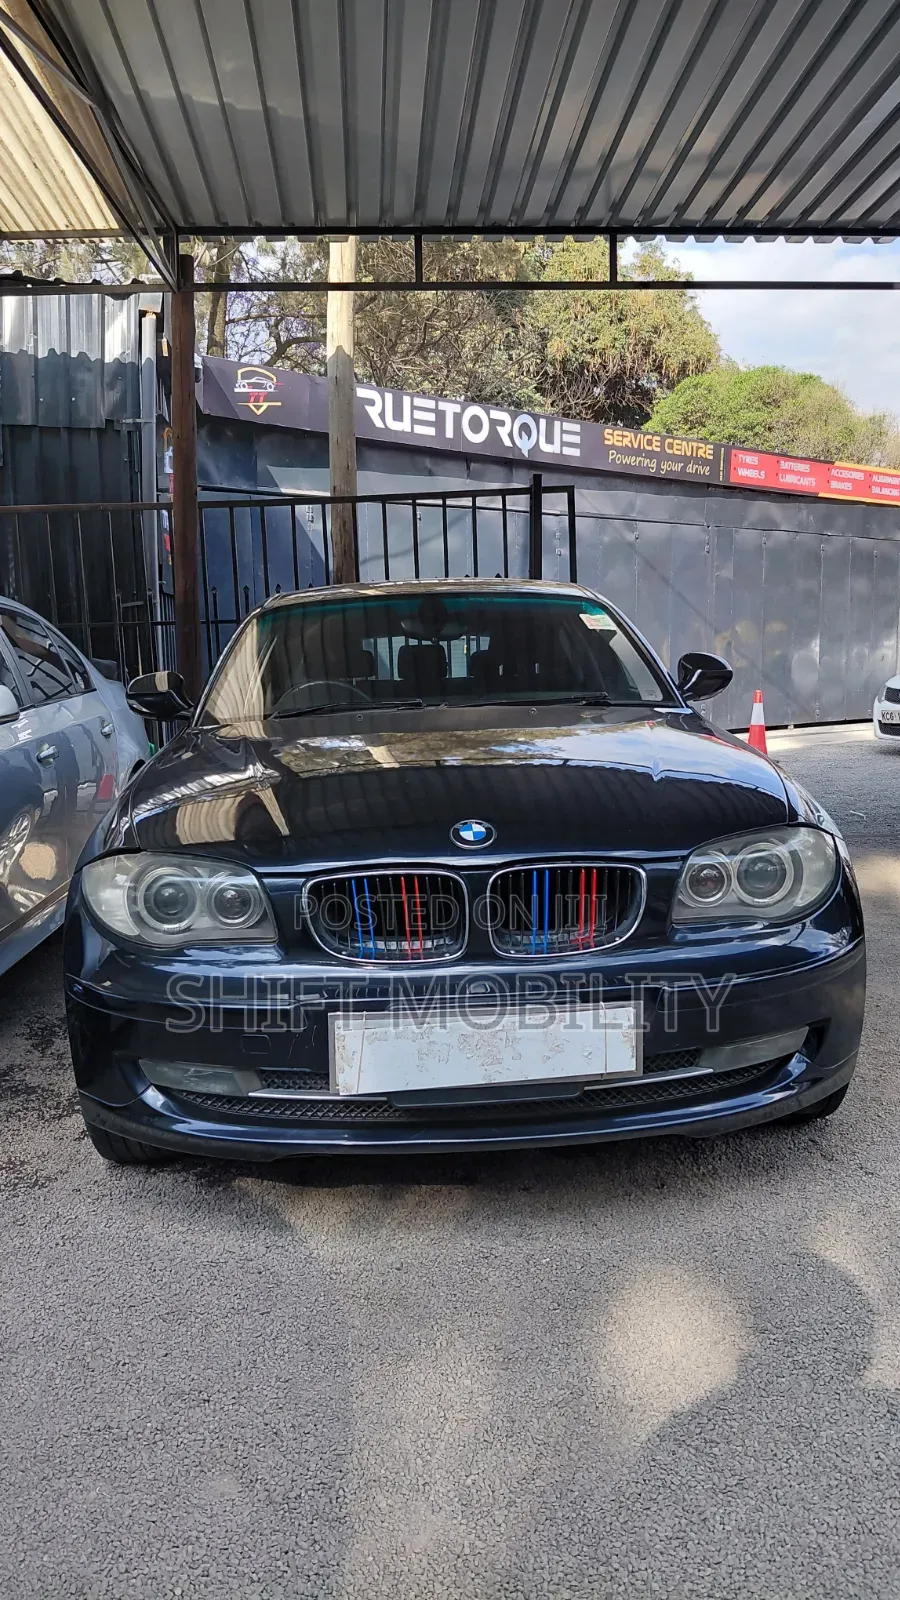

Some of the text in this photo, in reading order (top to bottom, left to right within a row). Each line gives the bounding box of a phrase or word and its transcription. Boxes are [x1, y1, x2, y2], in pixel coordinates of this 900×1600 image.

[604, 428, 714, 460] SERVICE CENTRE
[608, 449, 657, 473] Powering
[660, 459, 684, 475] your
[686, 460, 711, 476] drive
[738, 454, 759, 465] TYRES
[737, 467, 766, 480] WHEELS
[779, 473, 816, 487] LUBRICANTS
[830, 480, 853, 491] BRAKES
